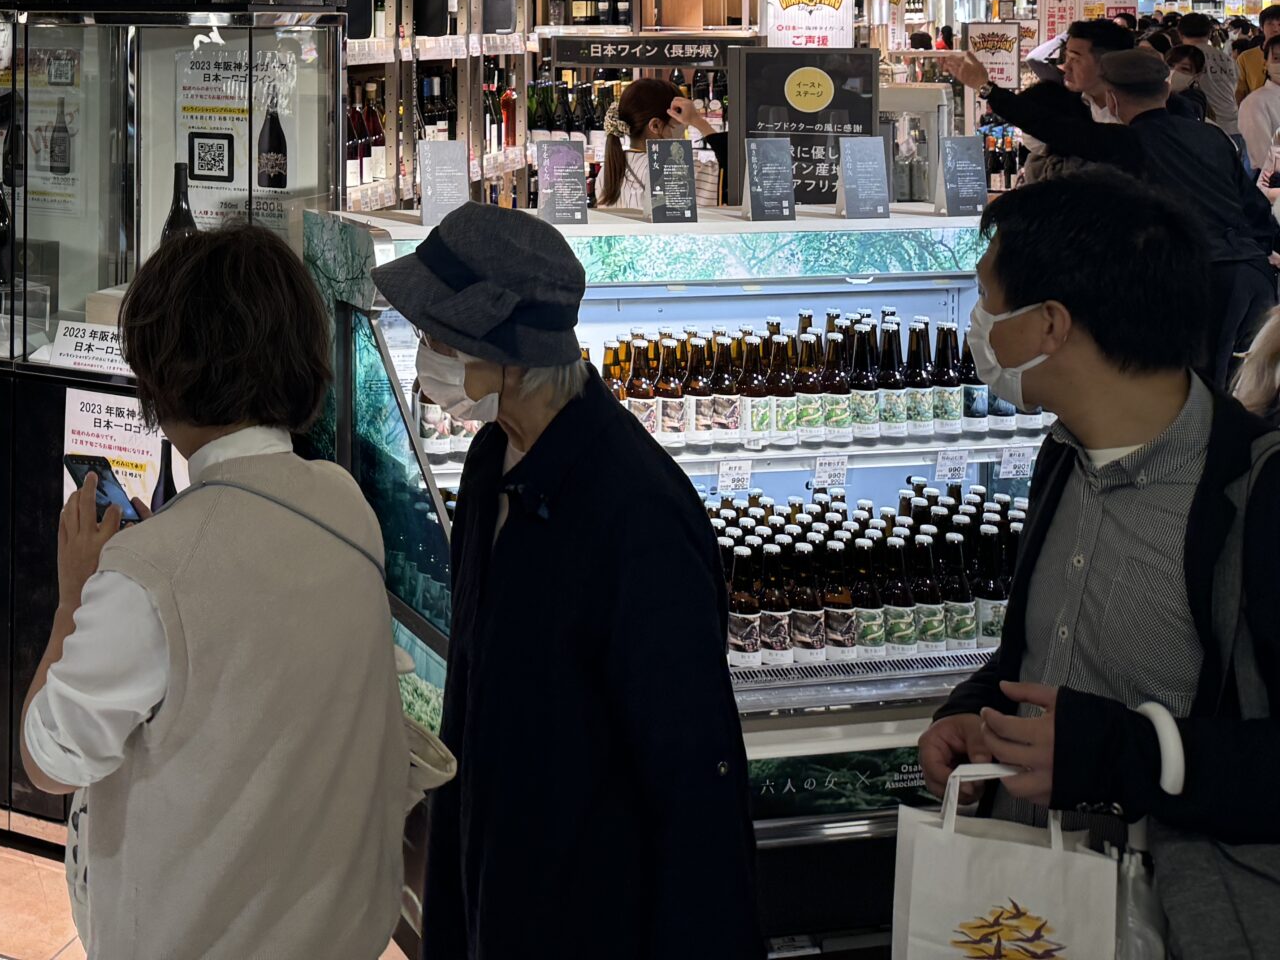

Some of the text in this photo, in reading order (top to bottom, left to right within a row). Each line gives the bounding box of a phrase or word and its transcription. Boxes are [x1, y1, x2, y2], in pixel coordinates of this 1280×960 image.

[792, 35, 829, 46] ご声援
[190, 61, 211, 70] 2023
[63, 326, 86, 339] 2023
[80, 402, 102, 414] 2023
[760, 773, 838, 795] 六人の女
